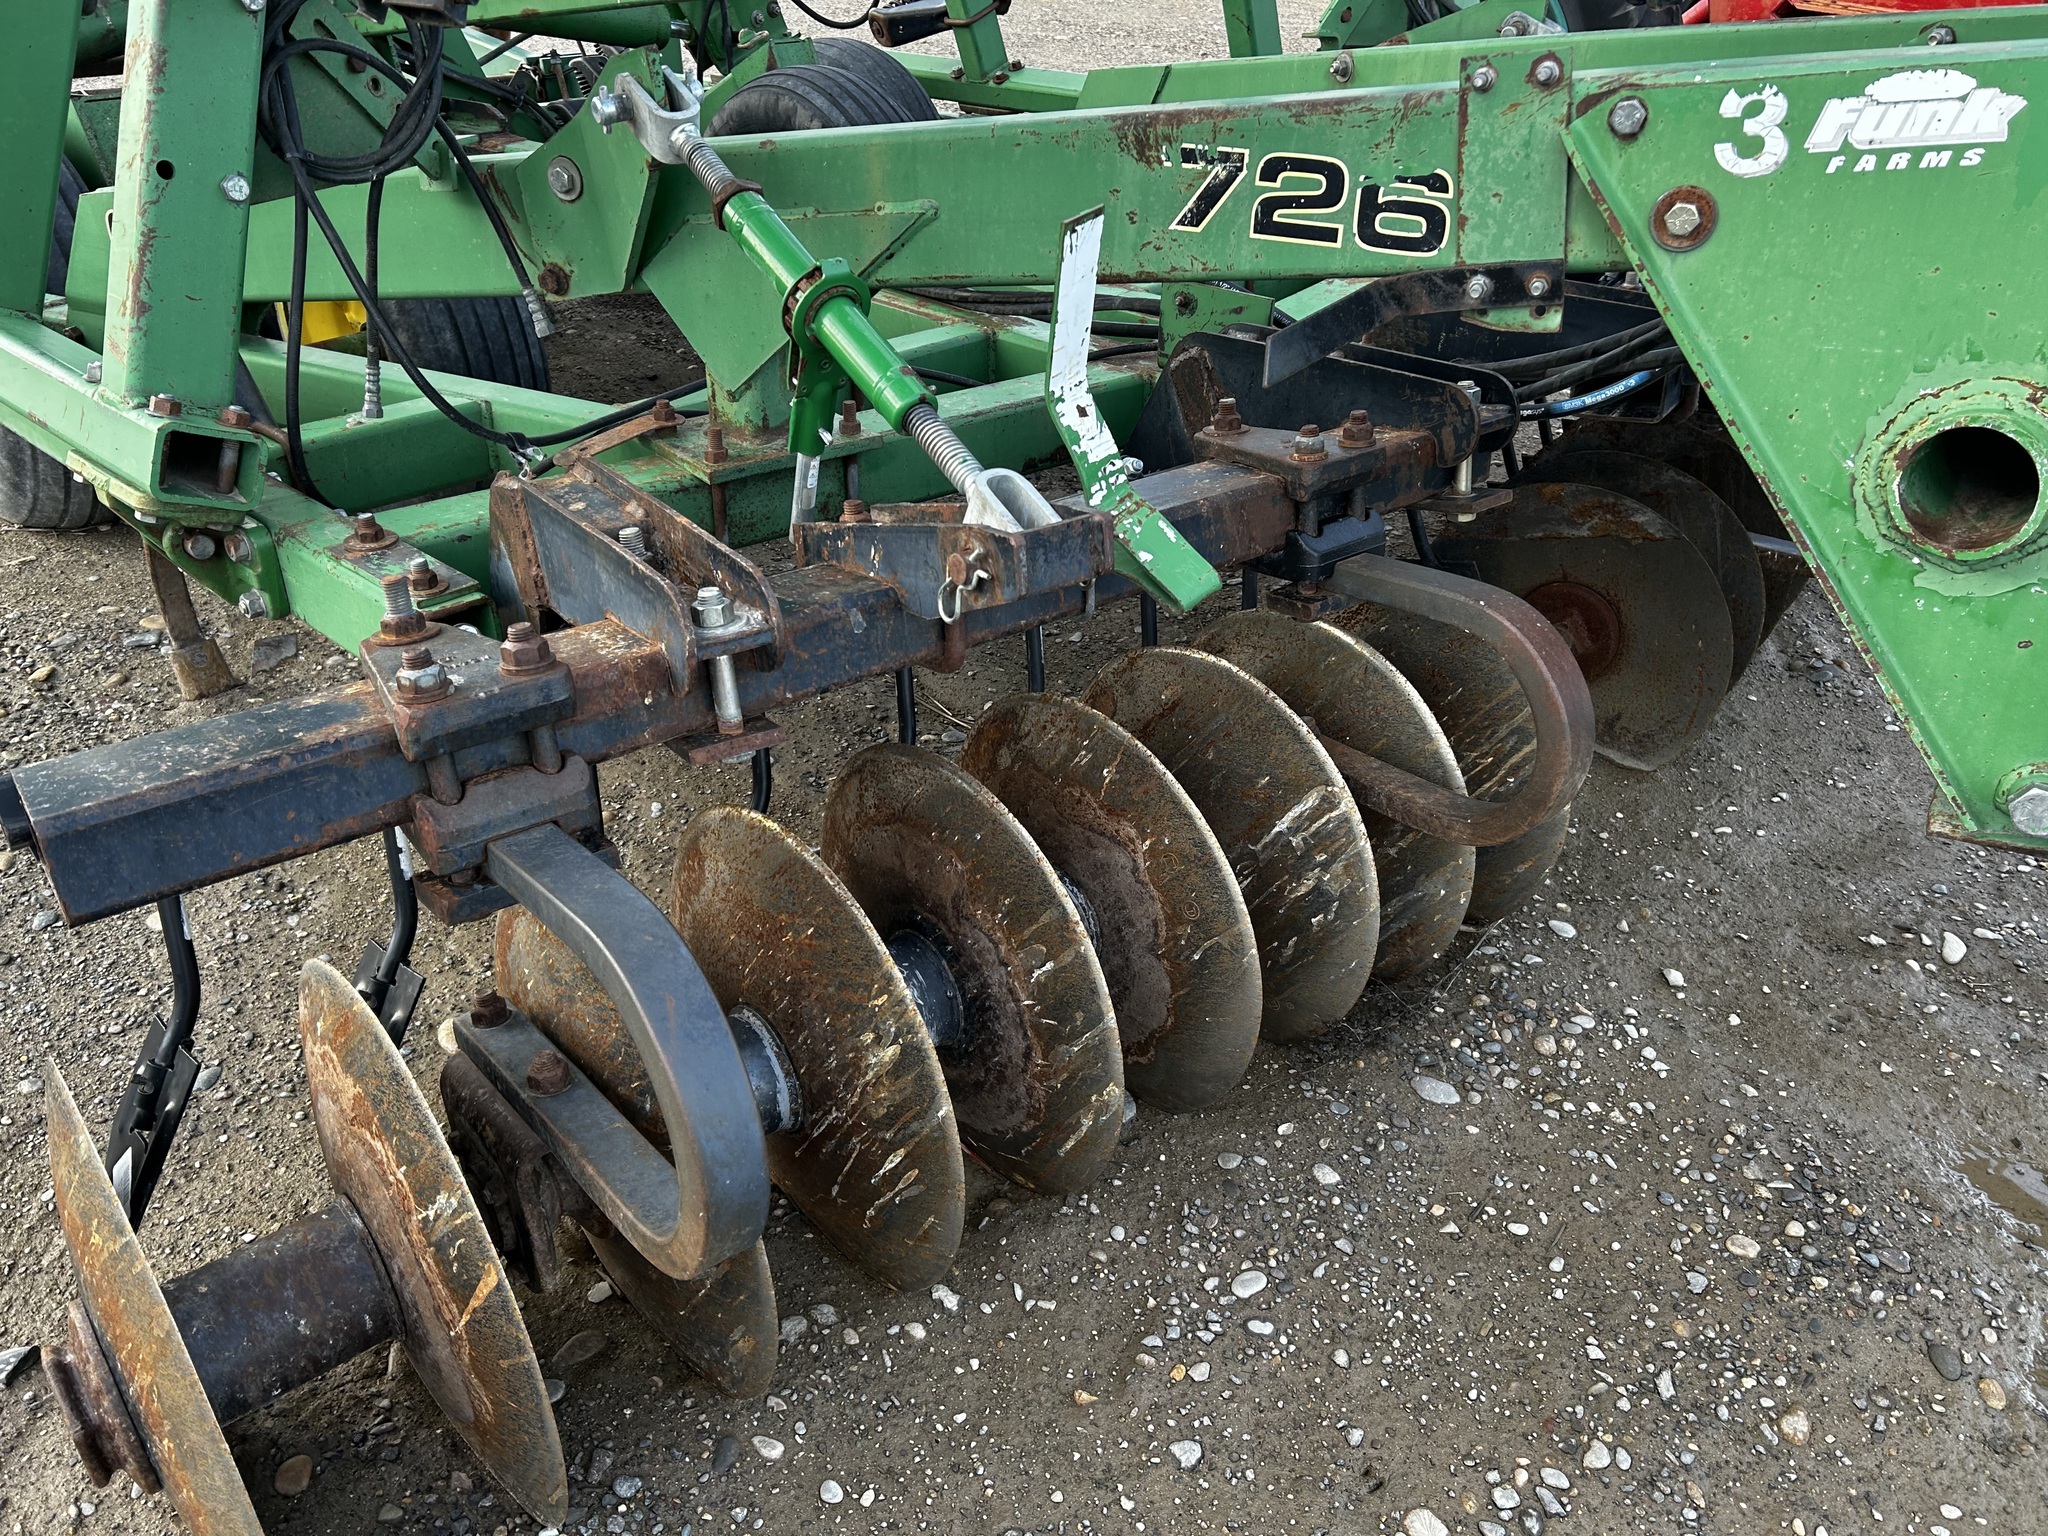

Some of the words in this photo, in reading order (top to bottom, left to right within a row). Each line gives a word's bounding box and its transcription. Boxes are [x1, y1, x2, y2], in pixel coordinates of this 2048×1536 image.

[1713, 83, 1789, 178] 3
[1803, 87, 2028, 153] Funk
[1162, 143, 1455, 258] 726
[1824, 148, 1986, 174] FARMS
